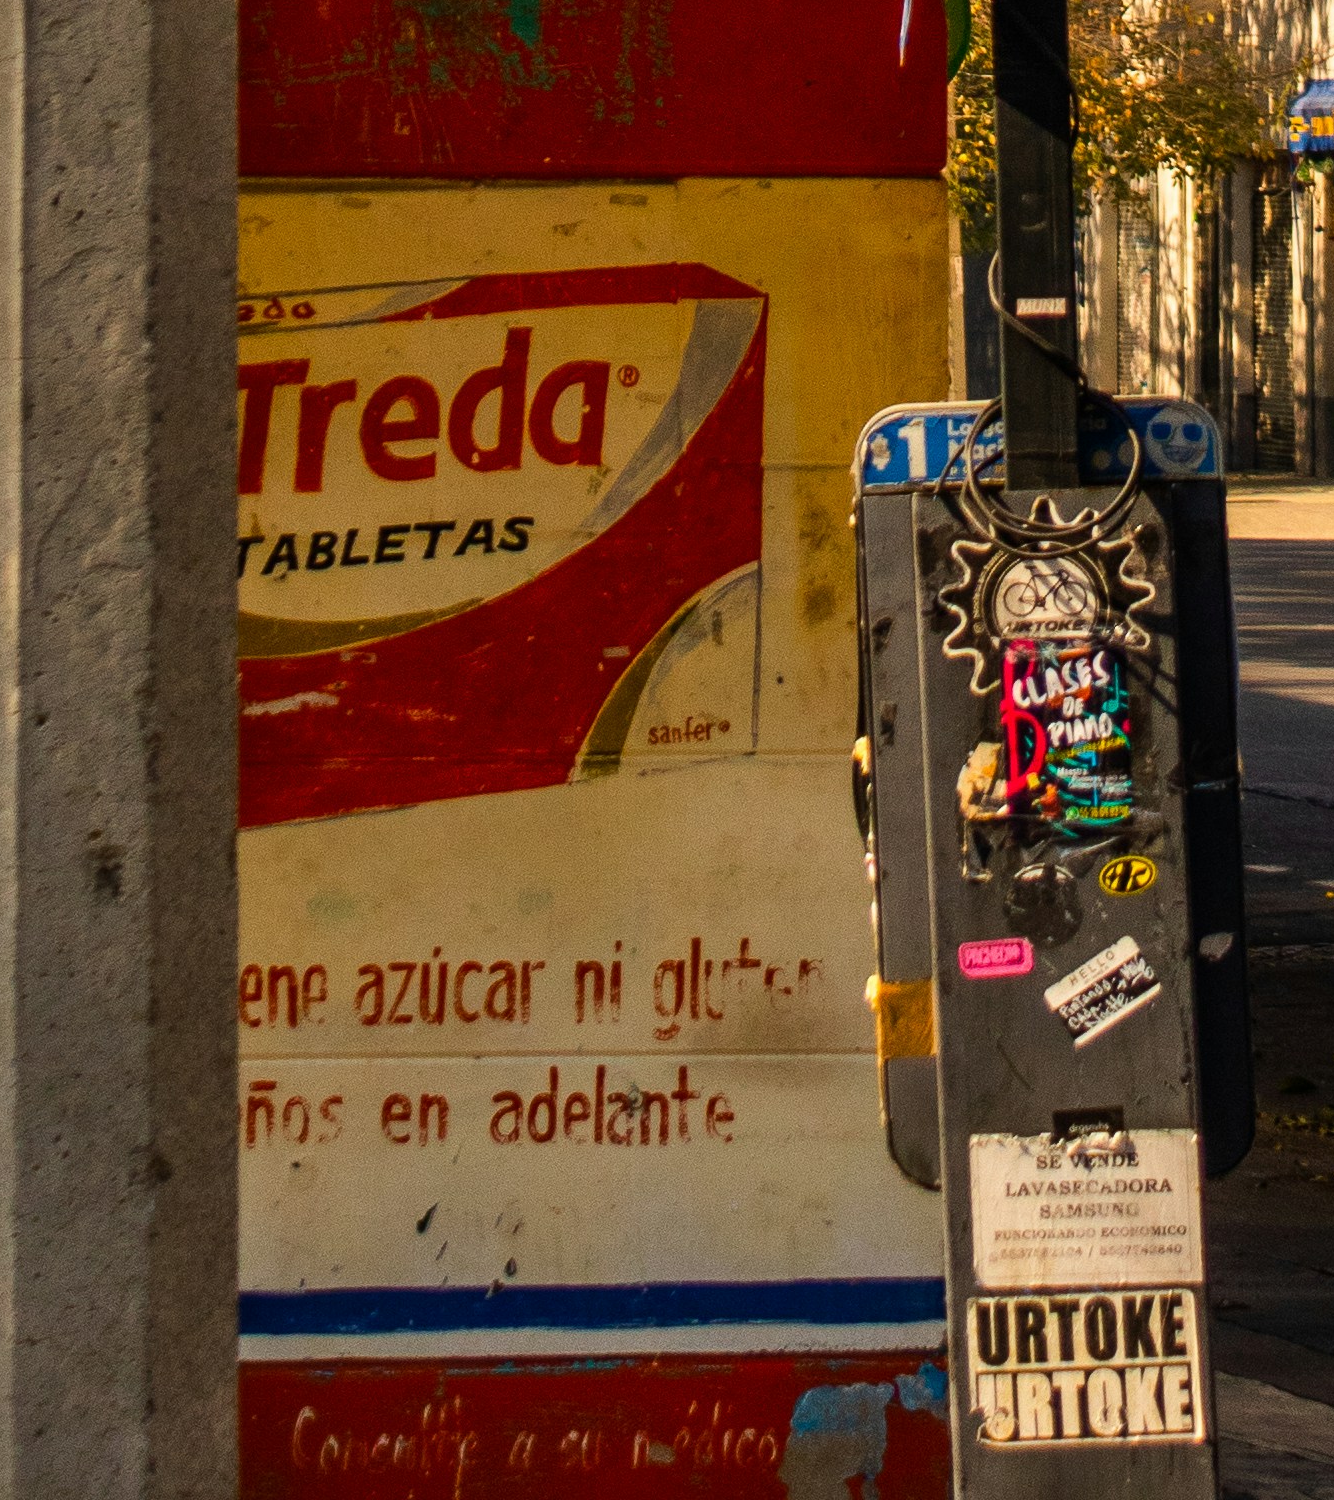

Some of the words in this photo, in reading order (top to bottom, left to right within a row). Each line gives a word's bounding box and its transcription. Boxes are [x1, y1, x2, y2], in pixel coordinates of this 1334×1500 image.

[1012, 650, 1110, 708] CLASES
[1047, 712, 1114, 747] PIANO
[355, 946, 546, 1027] azúcar
[574, 938, 624, 1024] ni
[1068, 949, 1116, 987] HELLO
[381, 1090, 450, 1148] en
[489, 1064, 736, 1148] adelante
[1035, 1154, 1063, 1170] SE
[1069, 1151, 1140, 1168] VENDE
[1005, 1178, 1173, 1198] LAVASECADORA
[1039, 1202, 1139, 1220] SAMSUNG
[994, 1227, 1096, 1242] FUNCIONANDO
[1100, 1224, 1188, 1239] ECONOMICO
[975, 1293, 1188, 1367] URTOKE
[977, 1364, 1196, 1443] URTOKE
